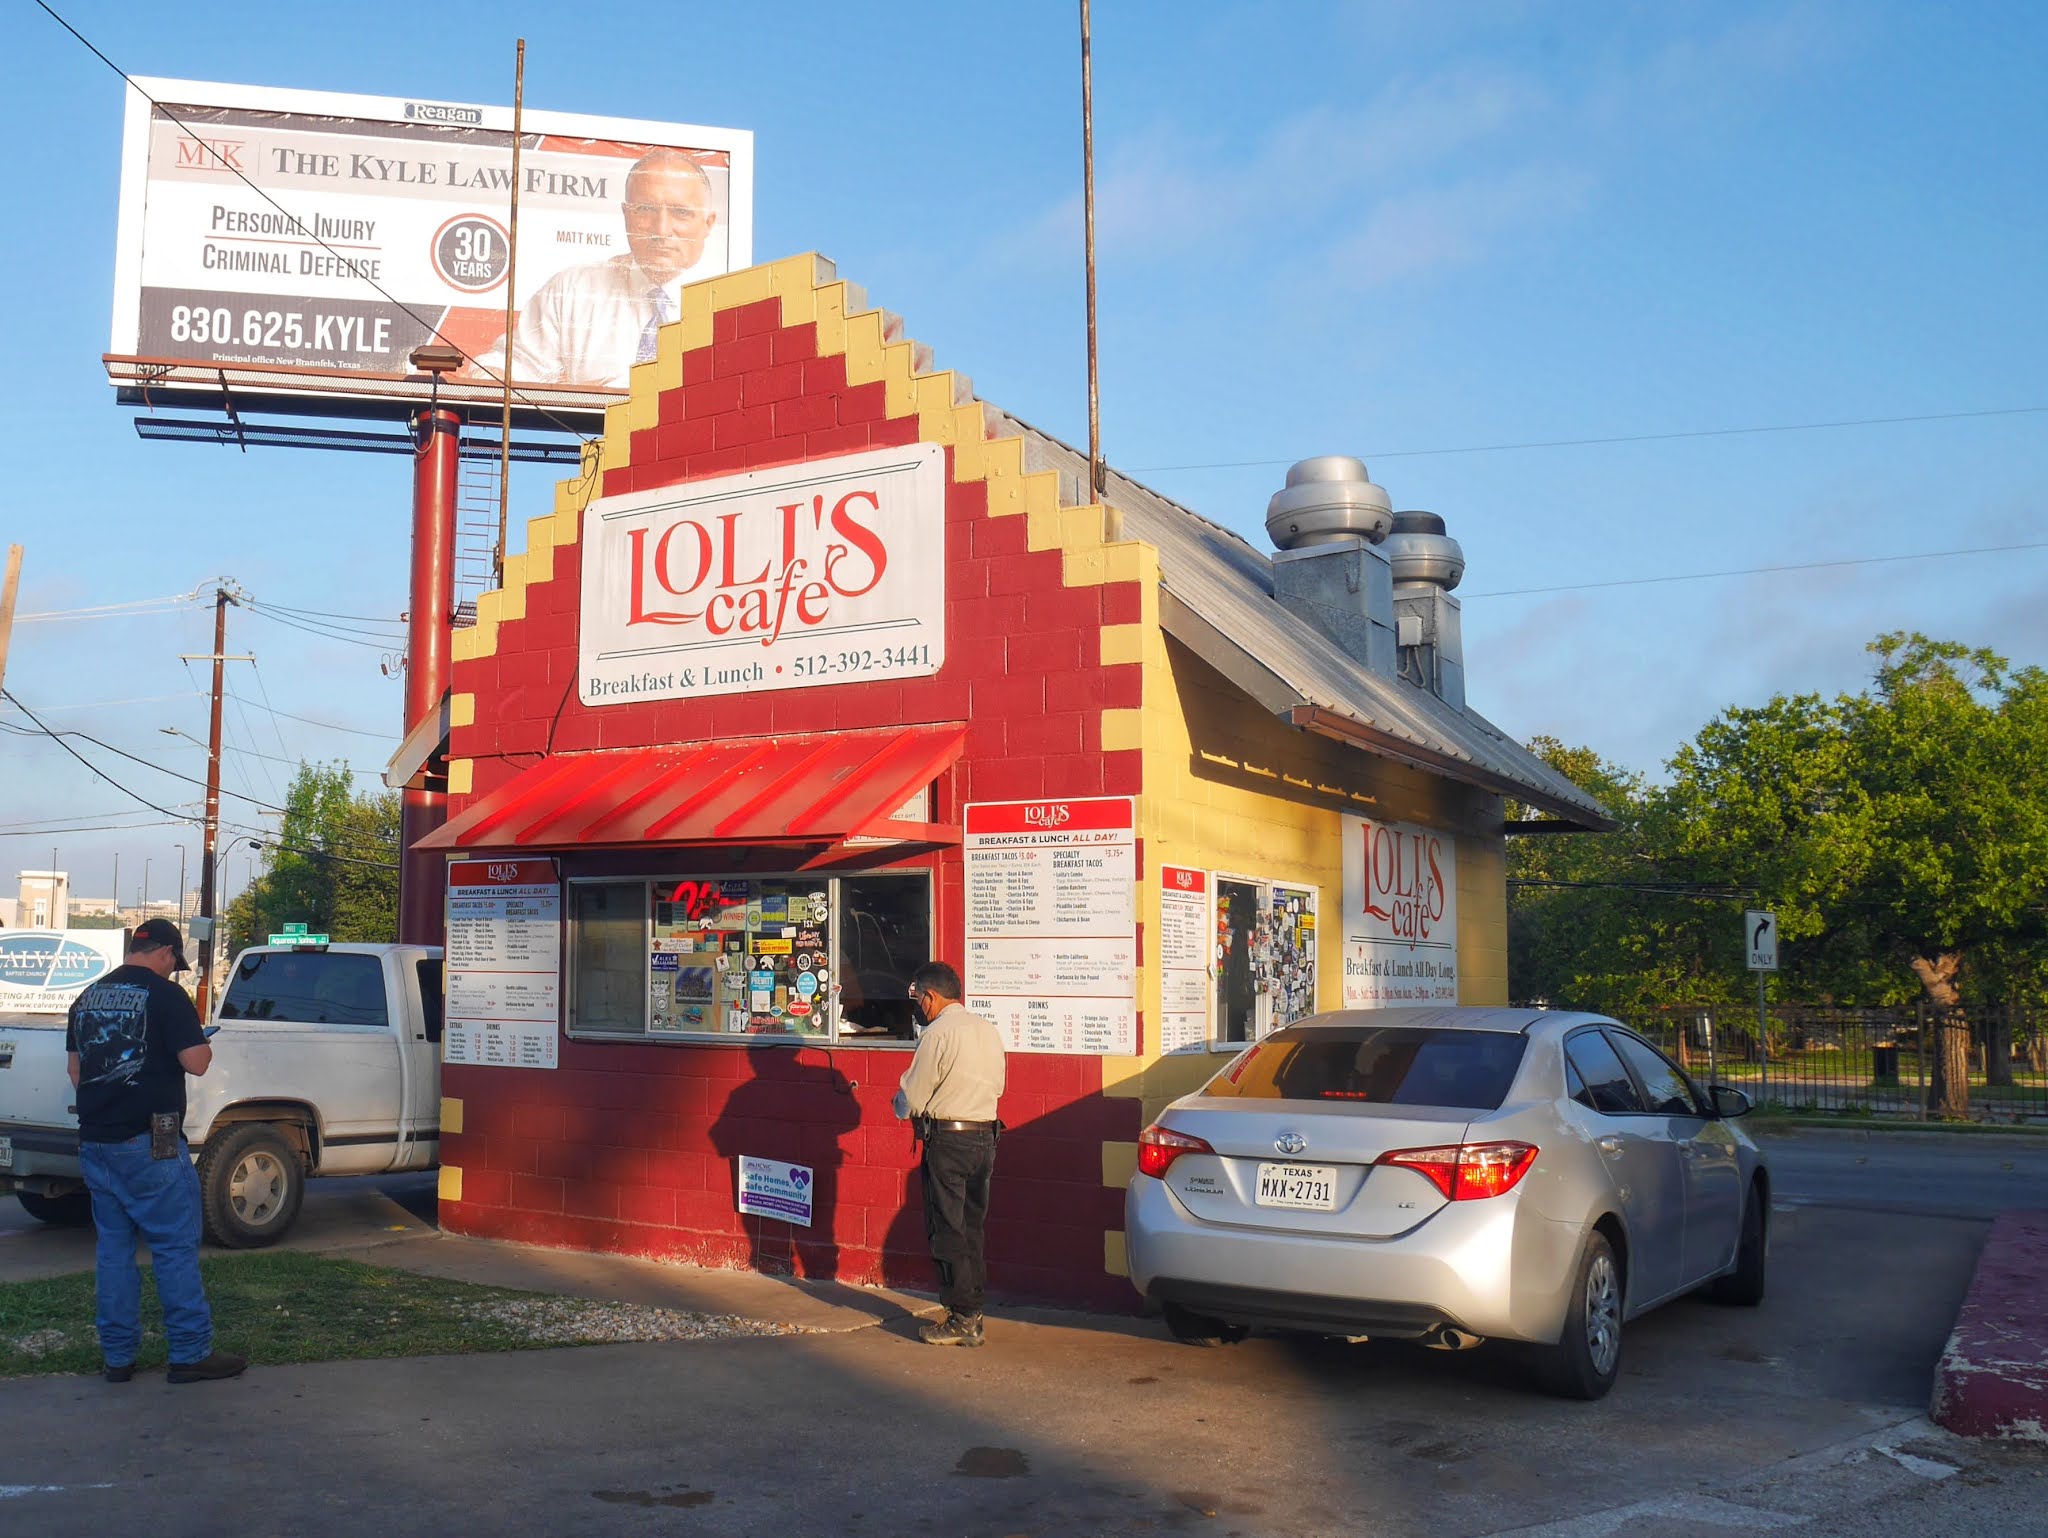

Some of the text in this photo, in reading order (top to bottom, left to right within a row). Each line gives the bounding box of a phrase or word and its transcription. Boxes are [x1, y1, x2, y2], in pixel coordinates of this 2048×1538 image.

[414, 104, 477, 123] Reagan
[272, 147, 608, 199] THE KYLE LAW FIRM
[212, 205, 376, 241] PERSONAL INJURY
[454, 227, 491, 262] 30
[556, 230, 612, 246] MATT KYLE
[202, 243, 381, 280] CRIMINAL DEFENSE
[453, 260, 491, 278] YEARS
[171, 306, 392, 353] 830.625.KYLE
[212, 353, 250, 363] Principal
[252, 356, 275, 365] office
[276, 357, 294, 366] New
[338, 361, 361, 369] Texas
[626, 490, 888, 627] LOLI'S
[589, 644, 930, 697] Breakfast & Lunch 512-392-3441
[1024, 804, 1069, 824] LOLI'S
[979, 836, 1030, 845] BREAKFAST
[1094, 833, 1117, 841] DAY!
[972, 852, 1000, 861] BREAKFAST
[1053, 851, 1080, 859] SPECIALTY
[1053, 860, 1084, 868] BREAKFAST
[1361, 824, 1444, 921] LOLI'S
[0, 946, 95, 969] ALVARY
[1752, 954, 1773, 966] ONLY
[1347, 958, 1455, 982] Breakfast & Lunch All Day Long.
[745, 1172, 792, 1188] Safe Homes,
[1283, 1168, 1312, 1177] TEXAS
[764, 1185, 807, 1202] Community
[1261, 1179, 1330, 1201] MXX 2731
